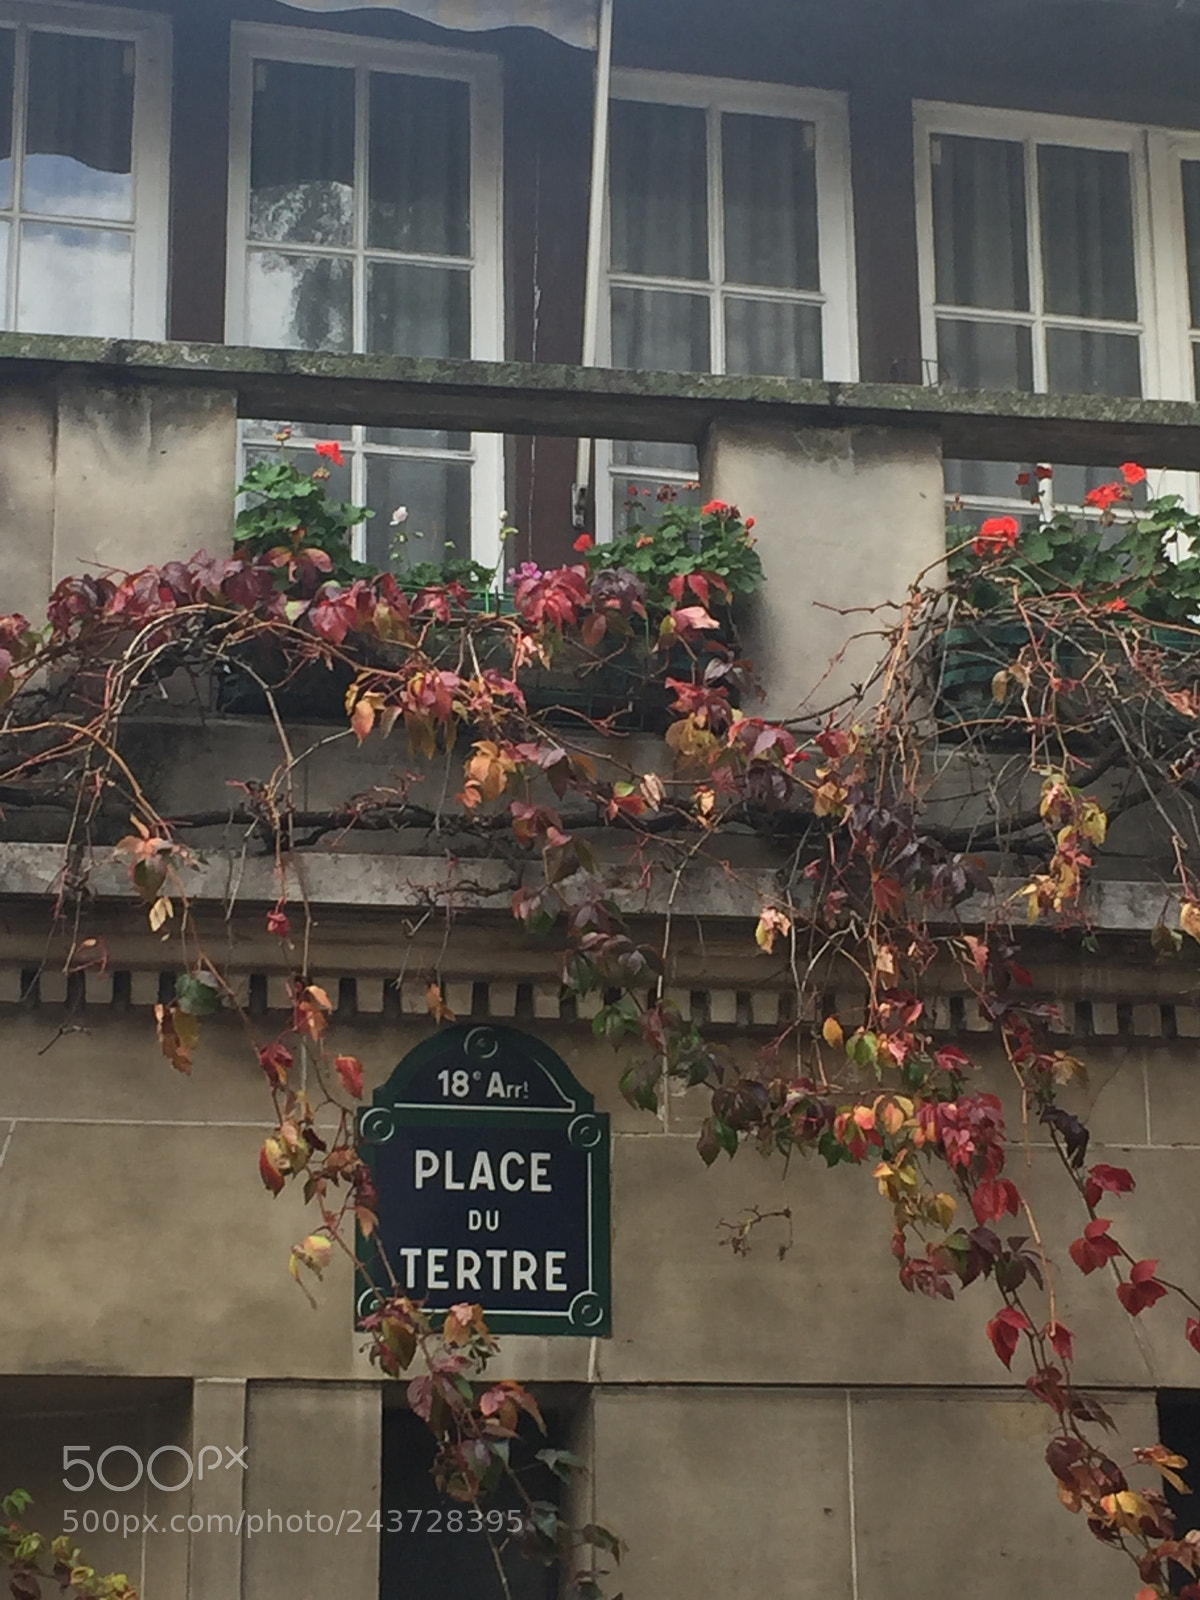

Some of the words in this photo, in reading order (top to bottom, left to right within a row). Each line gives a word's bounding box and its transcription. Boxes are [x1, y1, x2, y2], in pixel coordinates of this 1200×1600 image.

[414, 1149, 552, 1193] PLACE
[468, 1209, 499, 1231] DU
[400, 1247, 567, 1292] TERTRE
